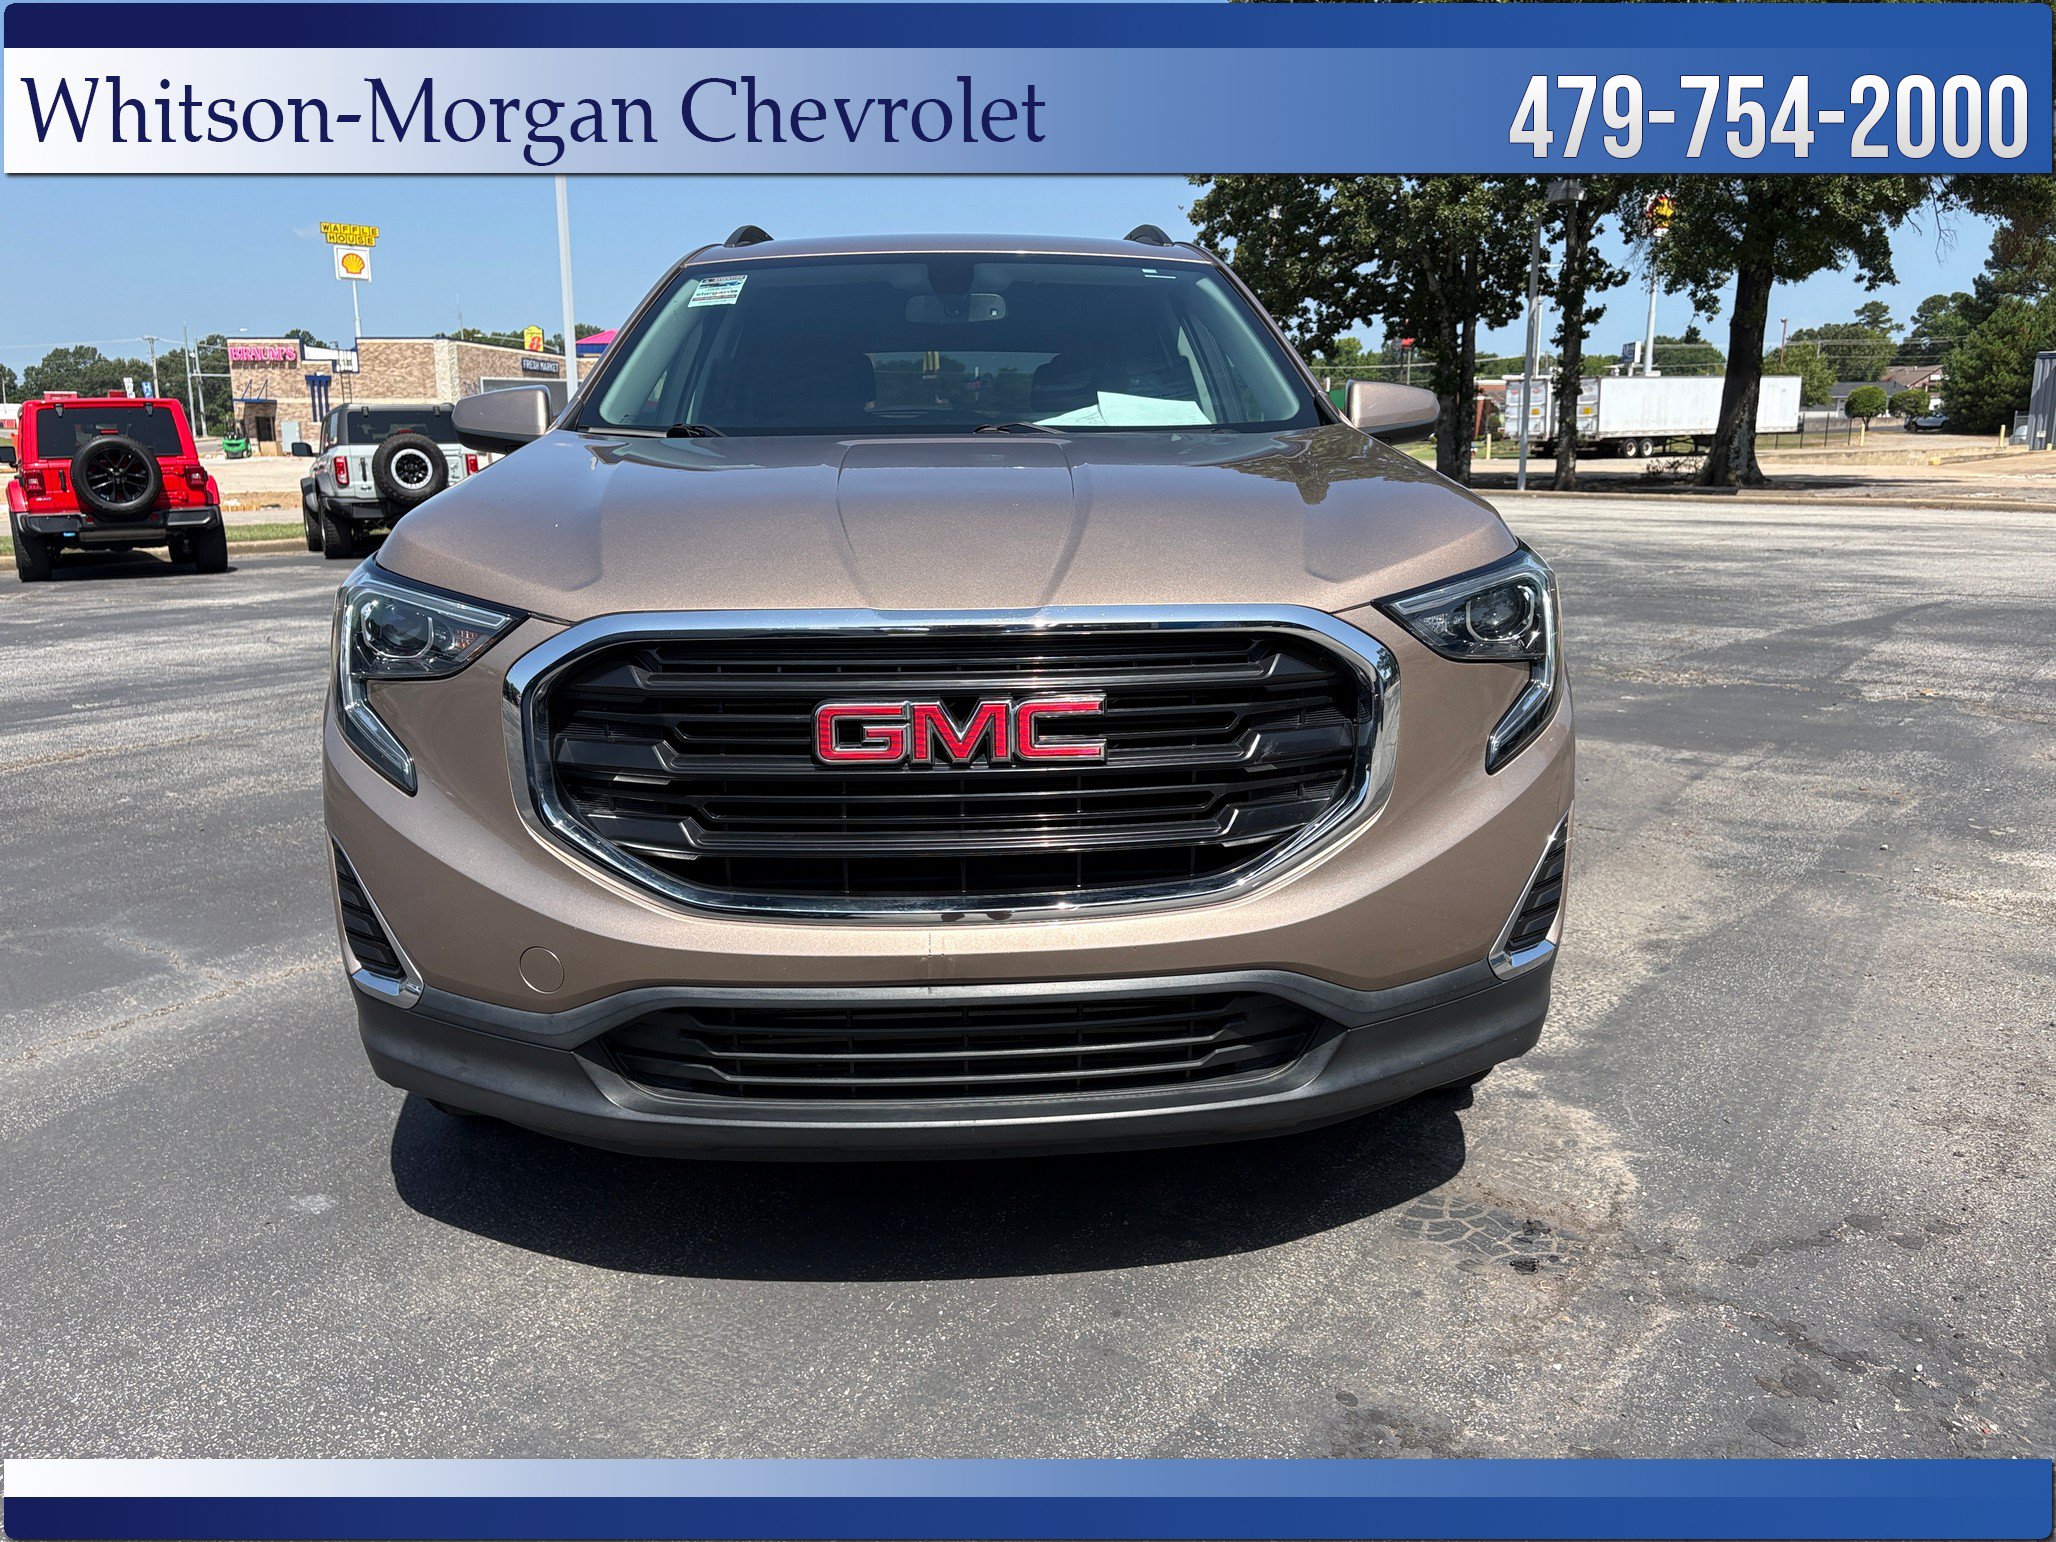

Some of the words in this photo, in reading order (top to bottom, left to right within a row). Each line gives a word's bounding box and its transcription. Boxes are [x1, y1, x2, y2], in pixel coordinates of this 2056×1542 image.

[322, 224, 378, 236] WAFFLE
[328, 234, 374, 245] HOUSE
[523, 359, 540, 371] FRESH
[540, 361, 559, 373] MARKET
[812, 694, 1107, 766] GMC
